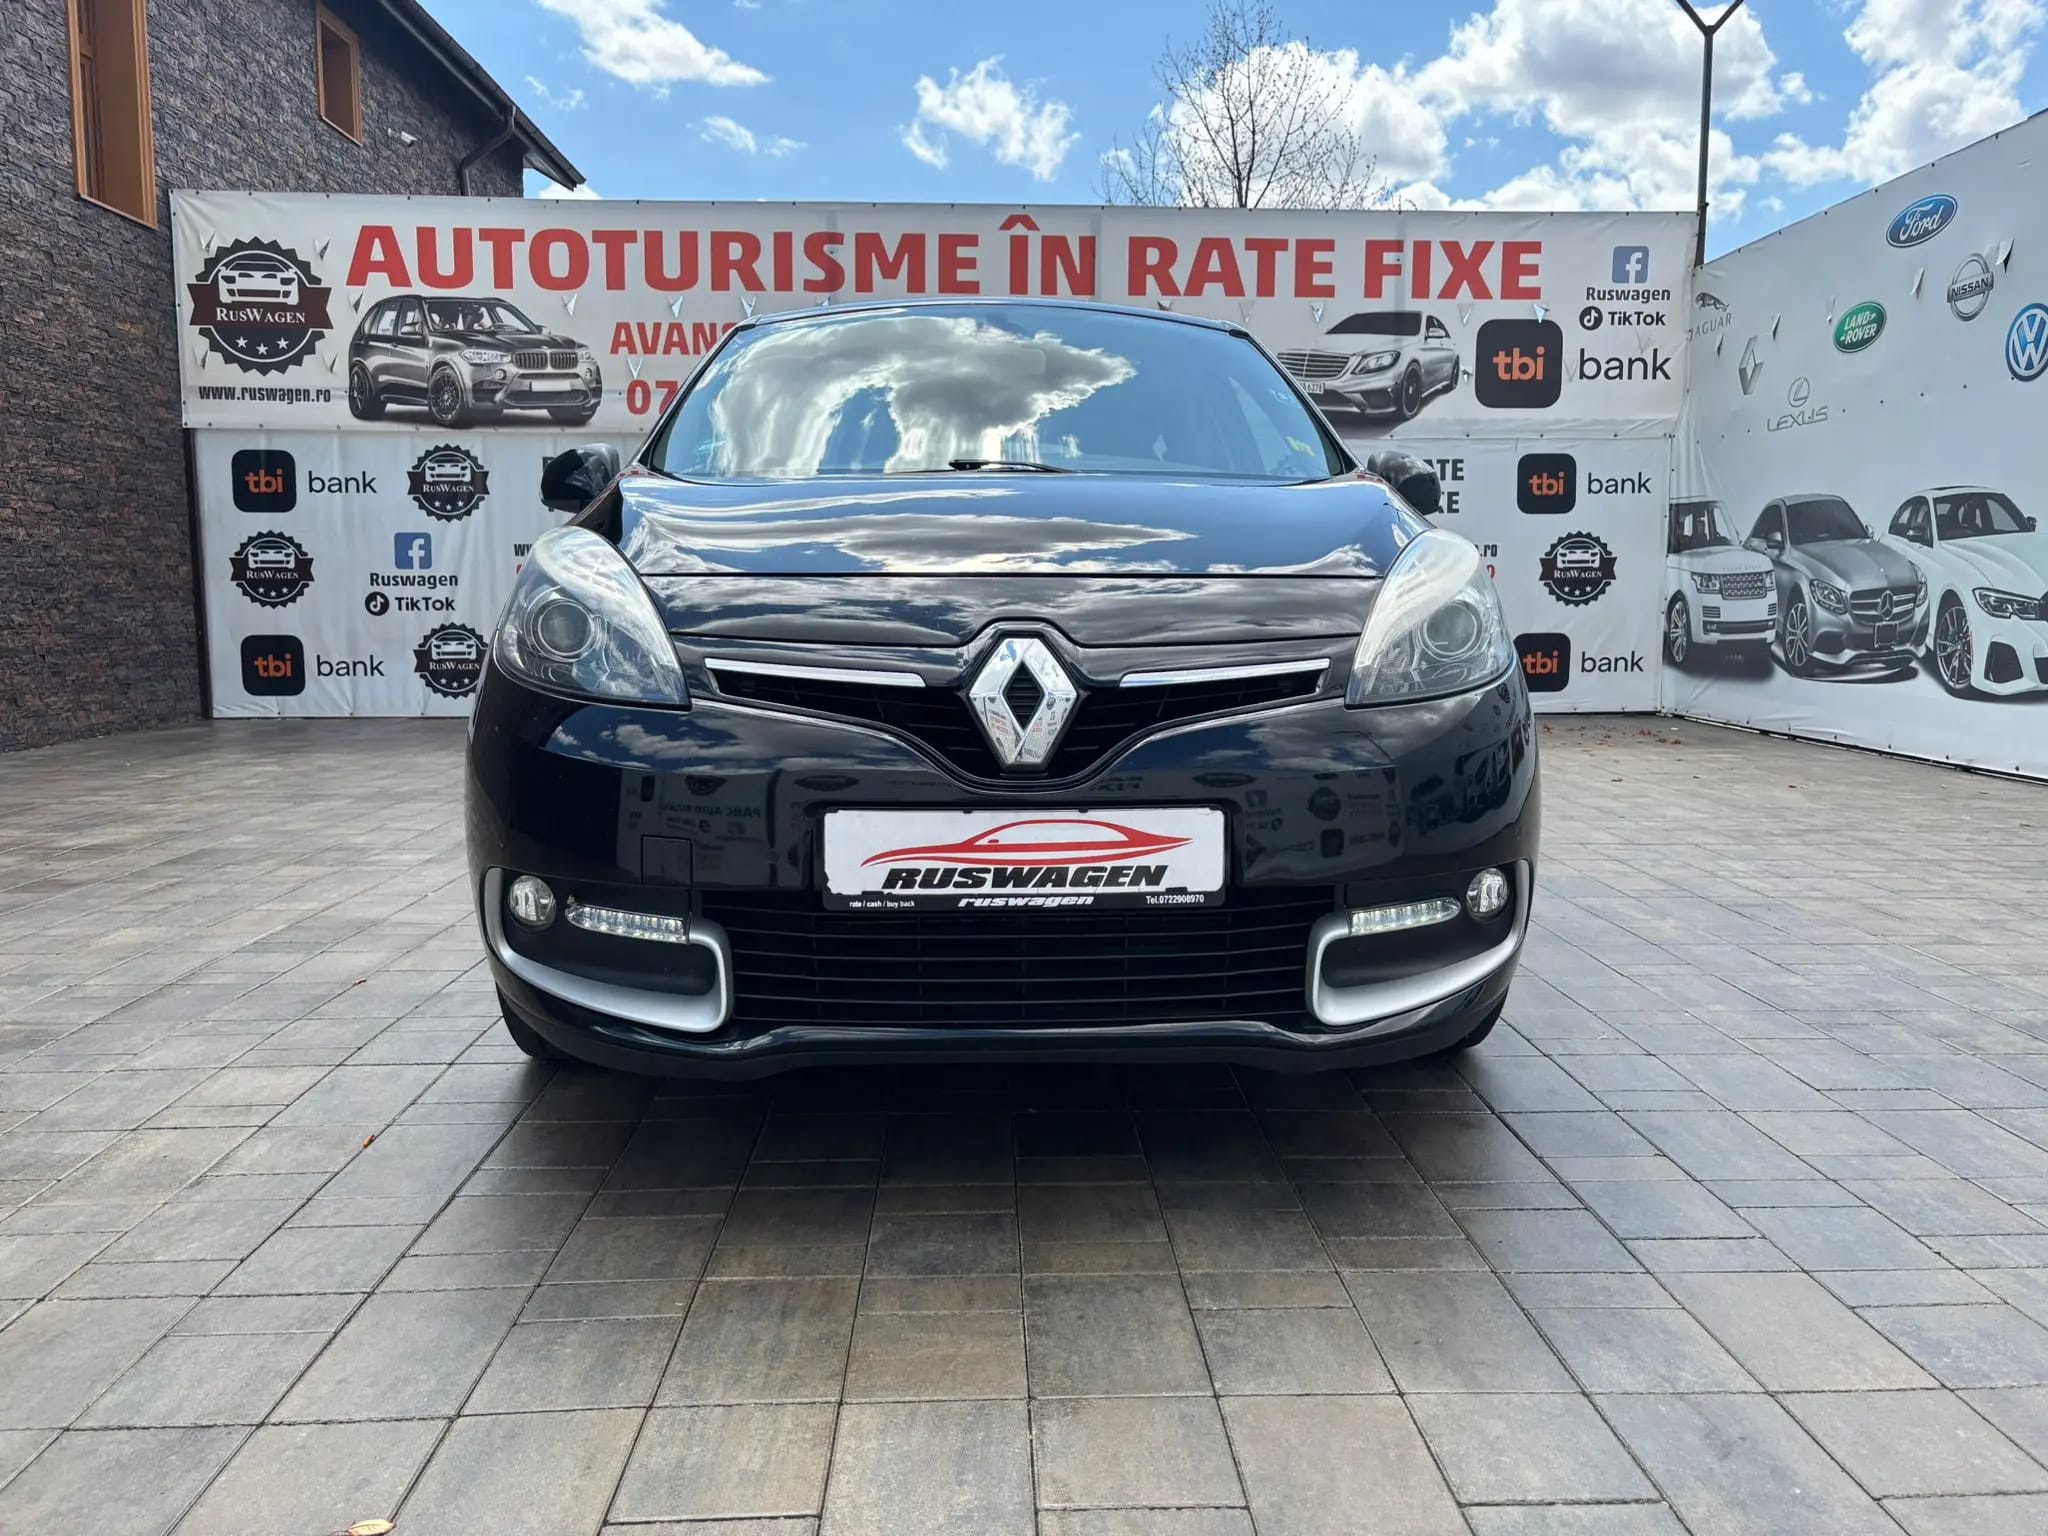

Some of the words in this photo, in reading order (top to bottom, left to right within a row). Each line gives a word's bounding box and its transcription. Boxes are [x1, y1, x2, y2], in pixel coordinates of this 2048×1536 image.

[1900, 201, 1944, 241] Ford
[346, 225, 980, 293] AUTOTURISME
[999, 213, 1095, 295] ÎN
[1129, 238, 1335, 297] RATE
[1365, 241, 1542, 299] FIXE
[1586, 286, 1671, 304] Ruswagen
[1951, 276, 1990, 297] NISSAN
[1607, 311, 1666, 326] TikTok
[1688, 312, 1732, 342] JAGUAR
[1844, 311, 1870, 330] LAND
[1845, 323, 1878, 344] ROVER
[1493, 346, 1545, 381] tbi
[1578, 348, 1672, 381] bank
[198, 386, 331, 405] www.ruswagen.ro
[1767, 405, 1829, 432] LEXUS
[246, 473, 284, 494] tbi
[308, 470, 377, 494] bank
[1529, 472, 1565, 495] tbi
[1587, 471, 1652, 495] bank
[369, 570, 459, 590] Ruswagen
[394, 595, 456, 612] TikTok
[254, 653, 292, 678] tbi
[315, 654, 385, 677] bank
[1523, 650, 1559, 674] tbi
[1579, 650, 1645, 673] bank
[881, 865, 1168, 889] RUSWAGEN
[887, 901, 898, 909] buy
[957, 895, 1095, 908] ruswagen
